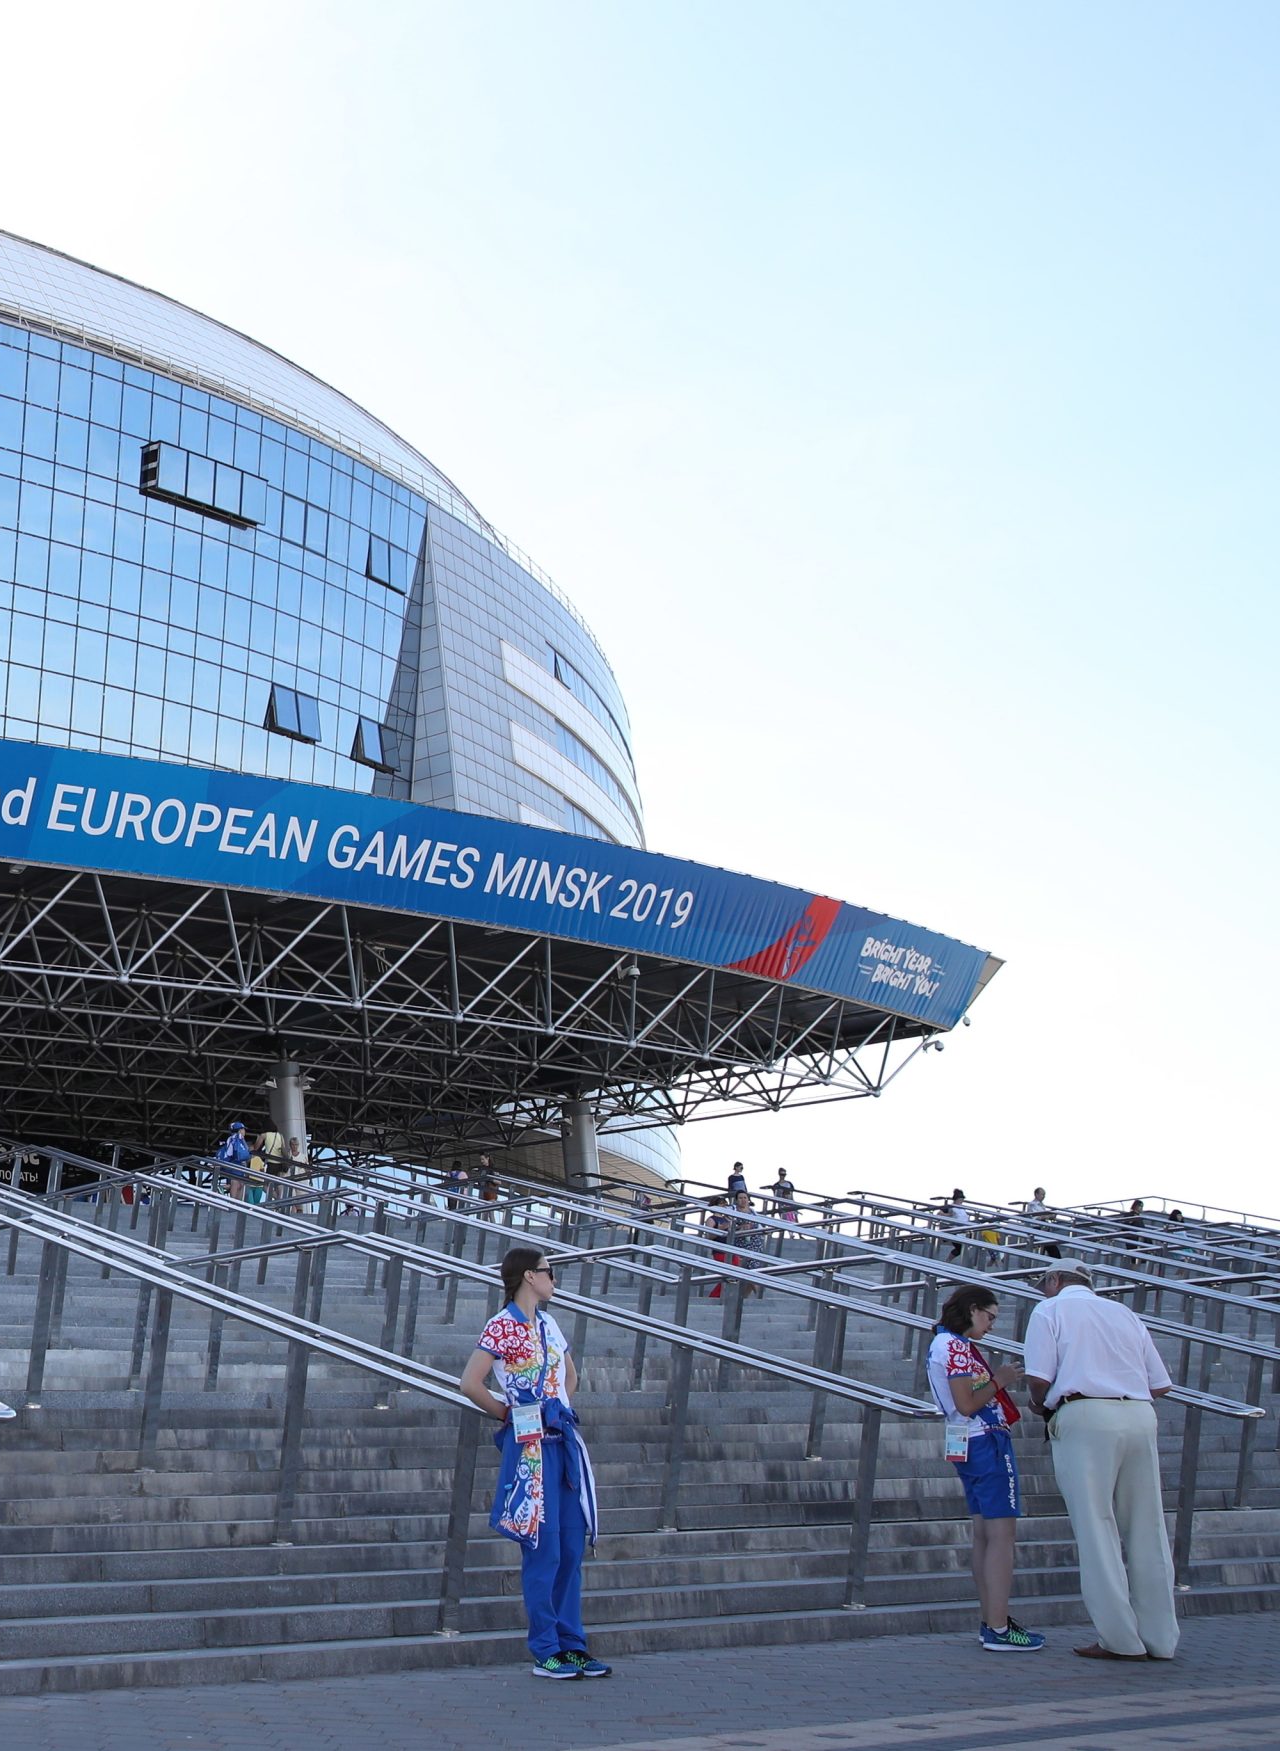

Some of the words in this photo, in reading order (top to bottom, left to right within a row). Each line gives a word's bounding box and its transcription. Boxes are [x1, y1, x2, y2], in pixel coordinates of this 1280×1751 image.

[46, 783, 319, 864] EUROPEAN
[327, 824, 481, 889] GAMES
[483, 851, 613, 915] MINSK
[609, 878, 695, 929] 2019
[861, 937, 906, 964] BRIGHT
[871, 963, 915, 991] BRIGHT
